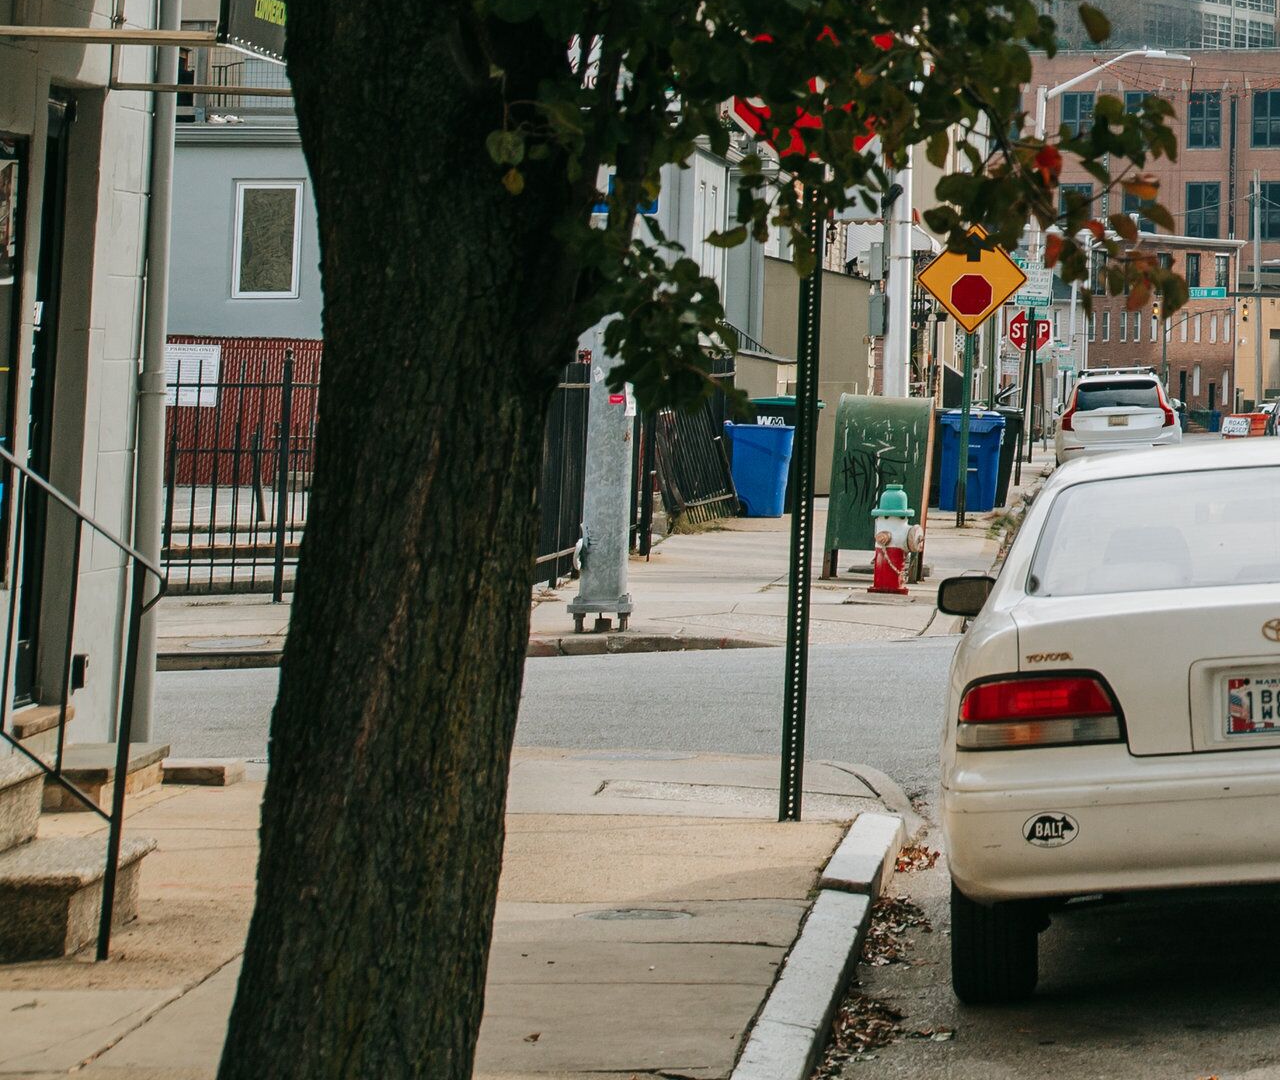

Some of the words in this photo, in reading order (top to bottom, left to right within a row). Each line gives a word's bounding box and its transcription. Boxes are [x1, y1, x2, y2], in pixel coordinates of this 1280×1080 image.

[1011, 322, 1049, 339] STP
[1025, 651, 1074, 664] TOYOTA
[1035, 821, 1064, 837] BALT
